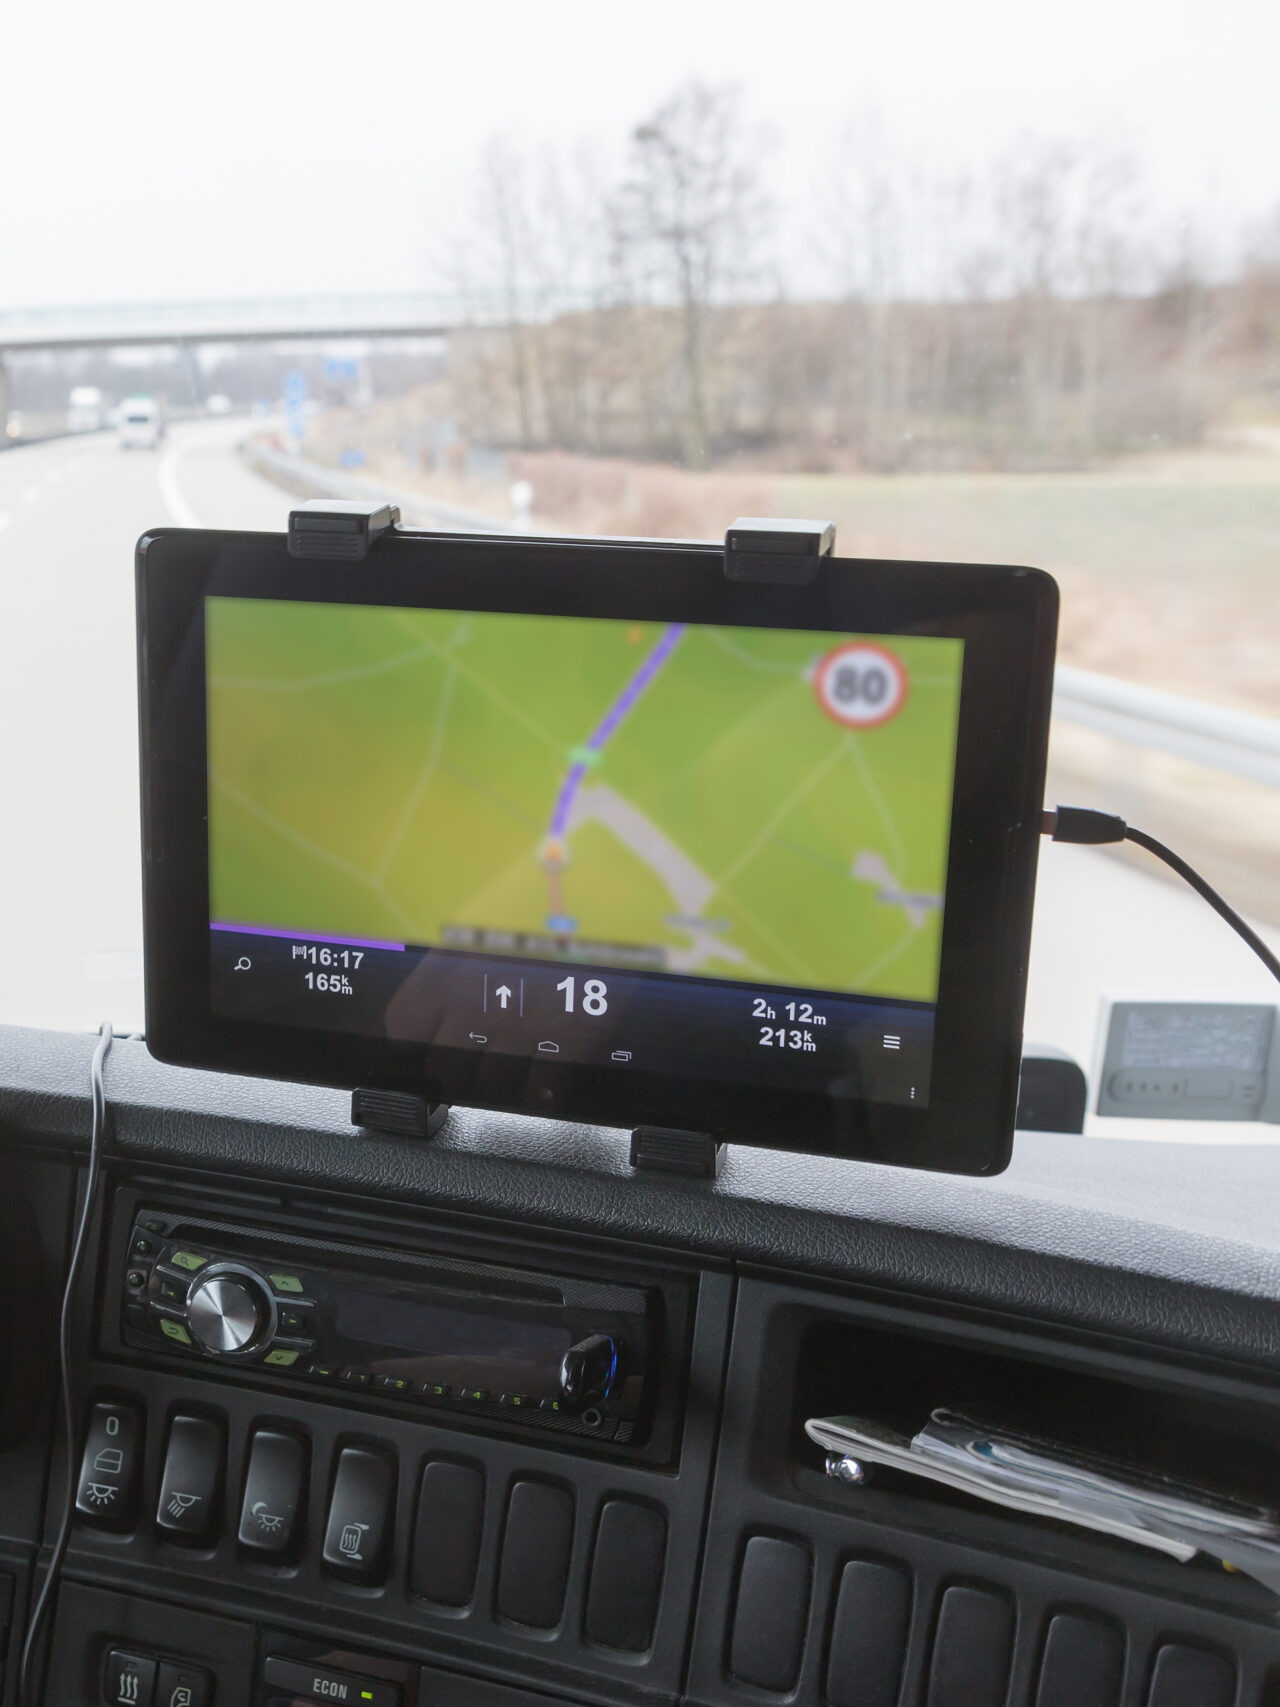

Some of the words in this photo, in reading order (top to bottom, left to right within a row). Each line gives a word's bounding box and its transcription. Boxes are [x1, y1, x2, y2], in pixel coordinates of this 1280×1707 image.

[833, 666, 889, 706] 80
[307, 946, 365, 969] 16:17
[556, 976, 608, 1016] 18
[752, 998, 776, 1020] 2h
[785, 1002, 827, 1026] 12m
[106, 1416, 119, 1435] 0
[313, 1678, 347, 1699] ECON
